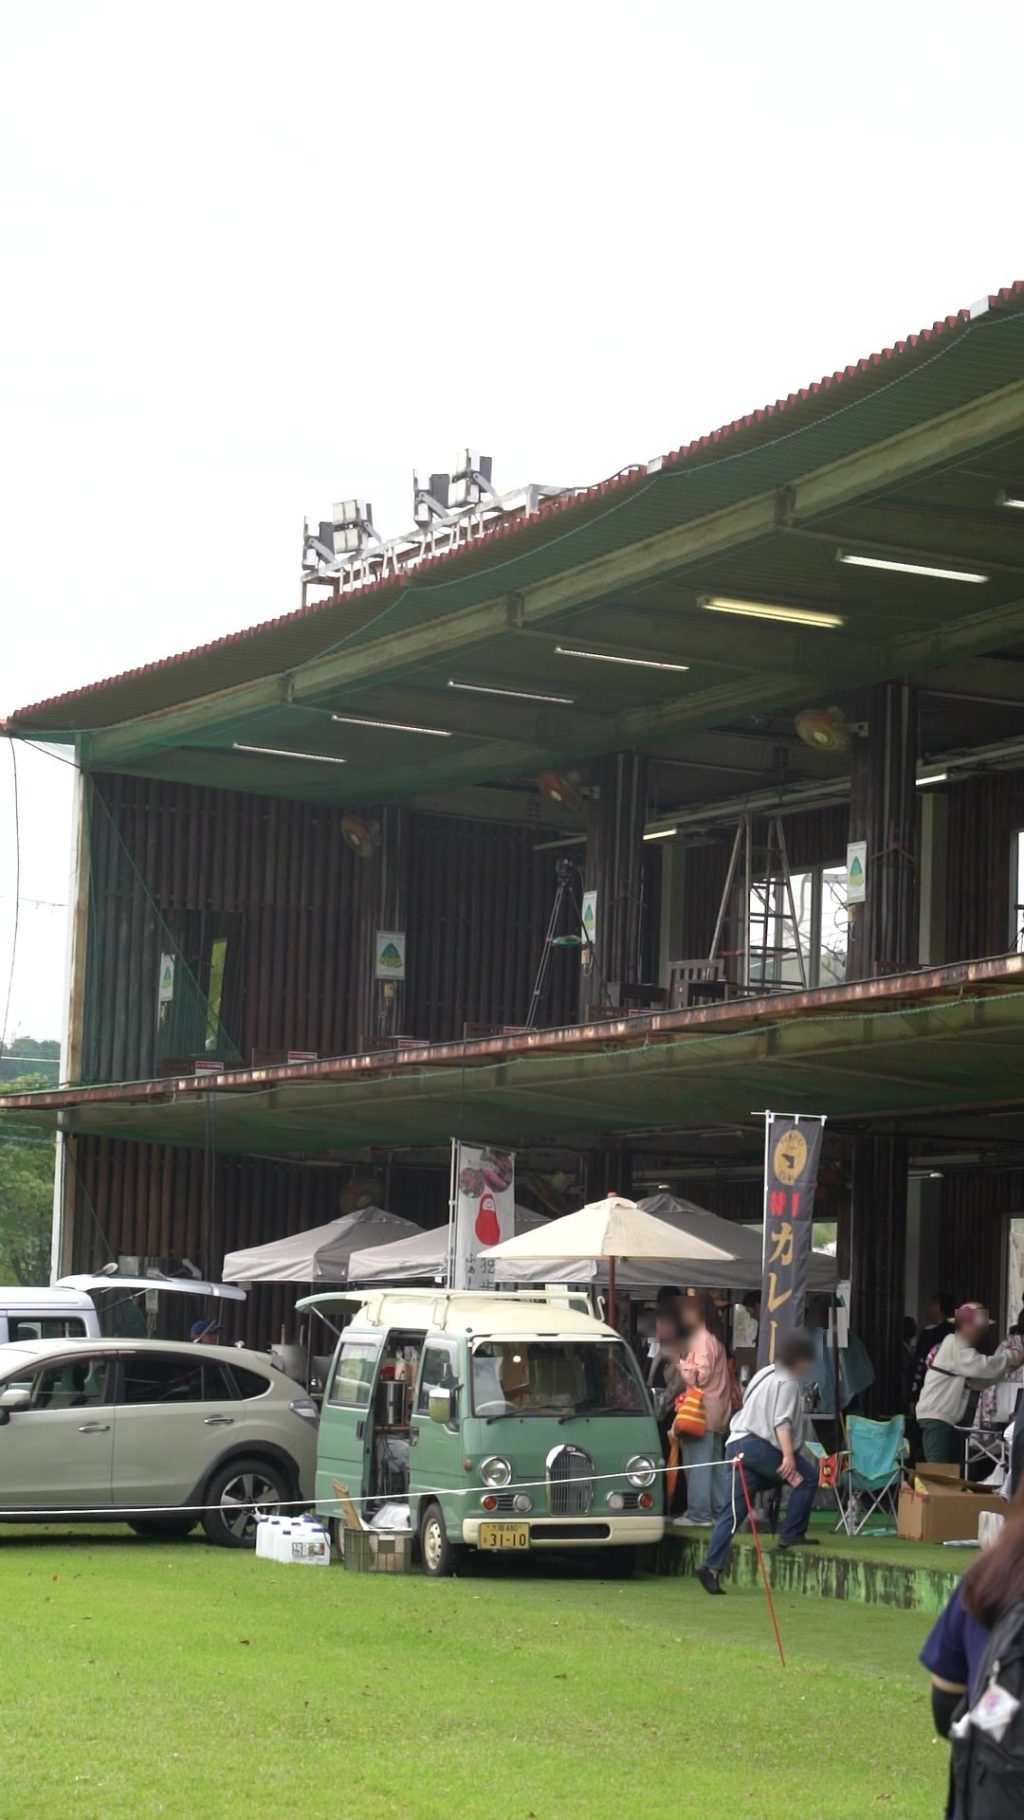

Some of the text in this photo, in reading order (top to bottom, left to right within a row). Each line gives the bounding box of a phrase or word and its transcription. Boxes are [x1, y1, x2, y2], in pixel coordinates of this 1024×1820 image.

[769, 1222, 794, 1364] カレー
[490, 1533, 526, 1547] 31-10
